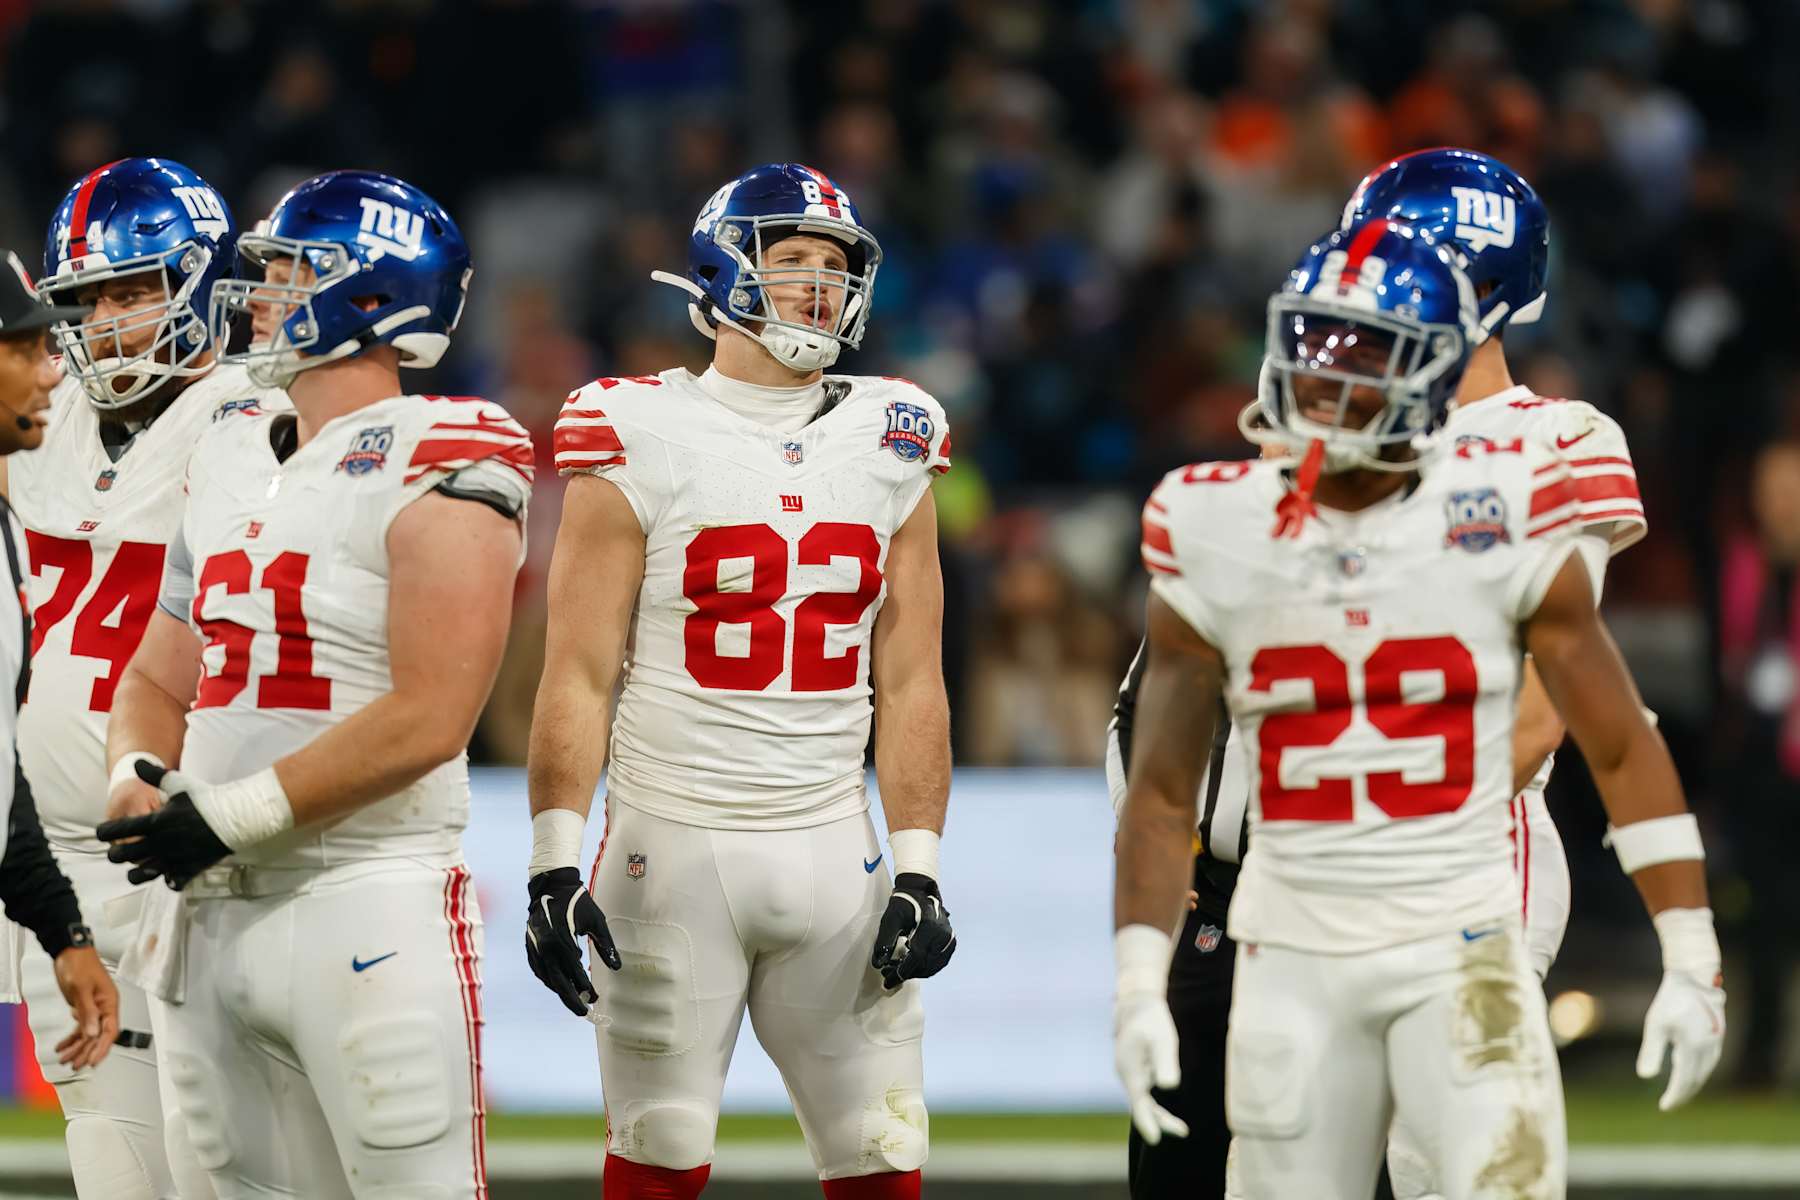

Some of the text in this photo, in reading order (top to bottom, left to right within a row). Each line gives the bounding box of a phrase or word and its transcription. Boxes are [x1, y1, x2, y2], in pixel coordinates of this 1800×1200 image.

[800, 181, 851, 212] 82
[785, 450, 801, 462] NFL
[888, 409, 932, 441] 100
[888, 431, 928, 449] SEASONS
[25, 528, 167, 713] 74
[190, 548, 333, 710] 61
[683, 522, 884, 692] 82
[1248, 634, 1479, 823] 29
